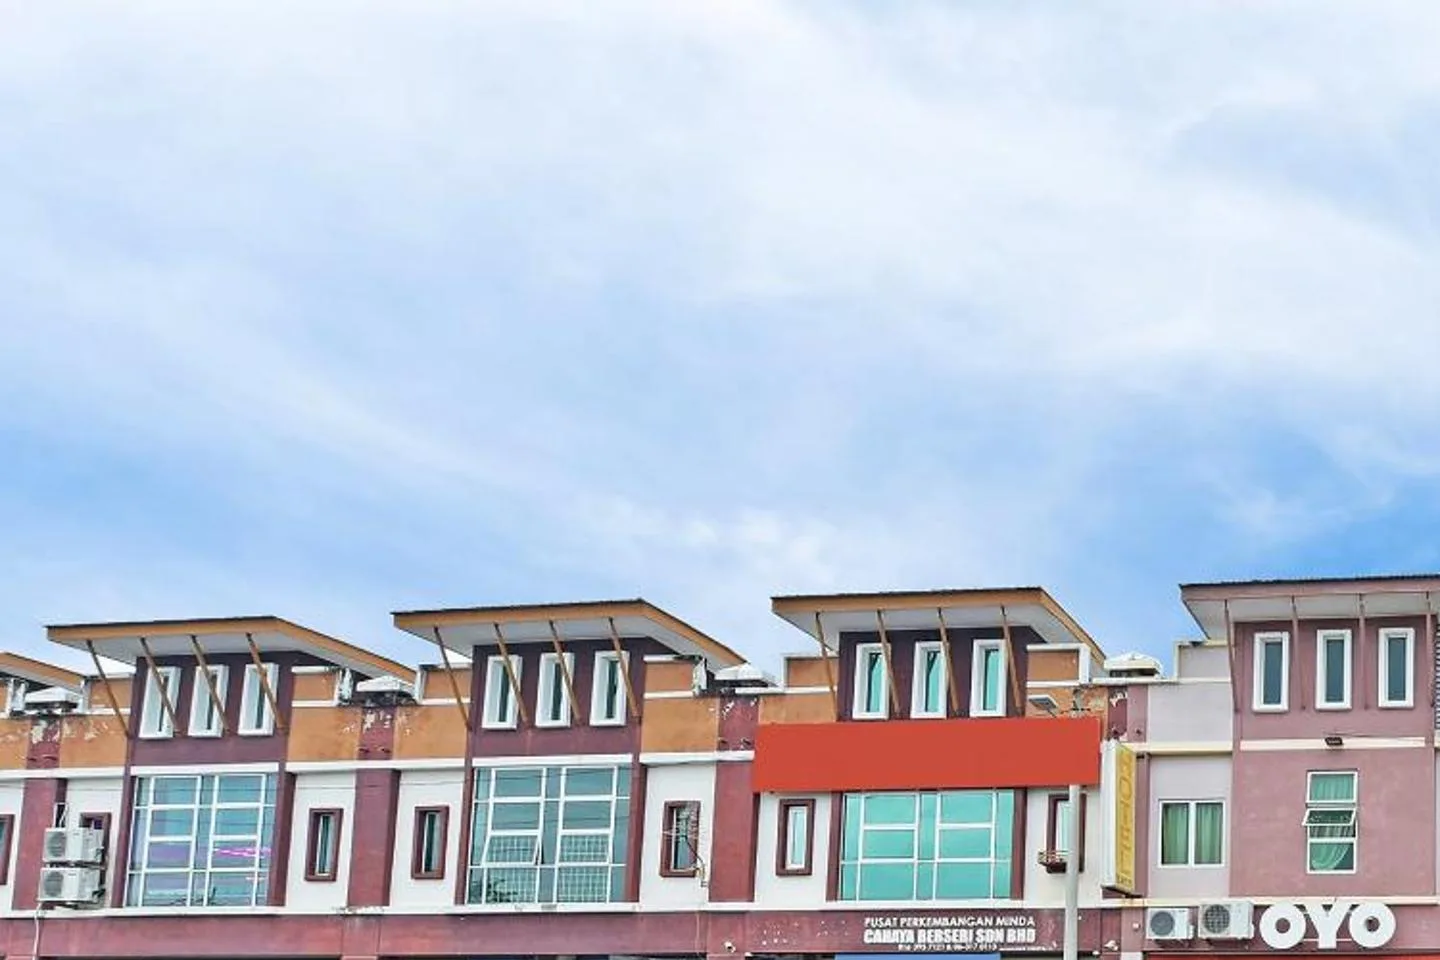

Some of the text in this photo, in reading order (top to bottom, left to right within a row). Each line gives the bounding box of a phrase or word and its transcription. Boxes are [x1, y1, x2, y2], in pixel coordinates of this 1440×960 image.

[864, 915, 1036, 929] PUSAT PERKEMBANGAN MINDA
[1259, 901, 1397, 950] OYO
[863, 928, 1036, 944] CAHAYA BERSERI SDN BHD
